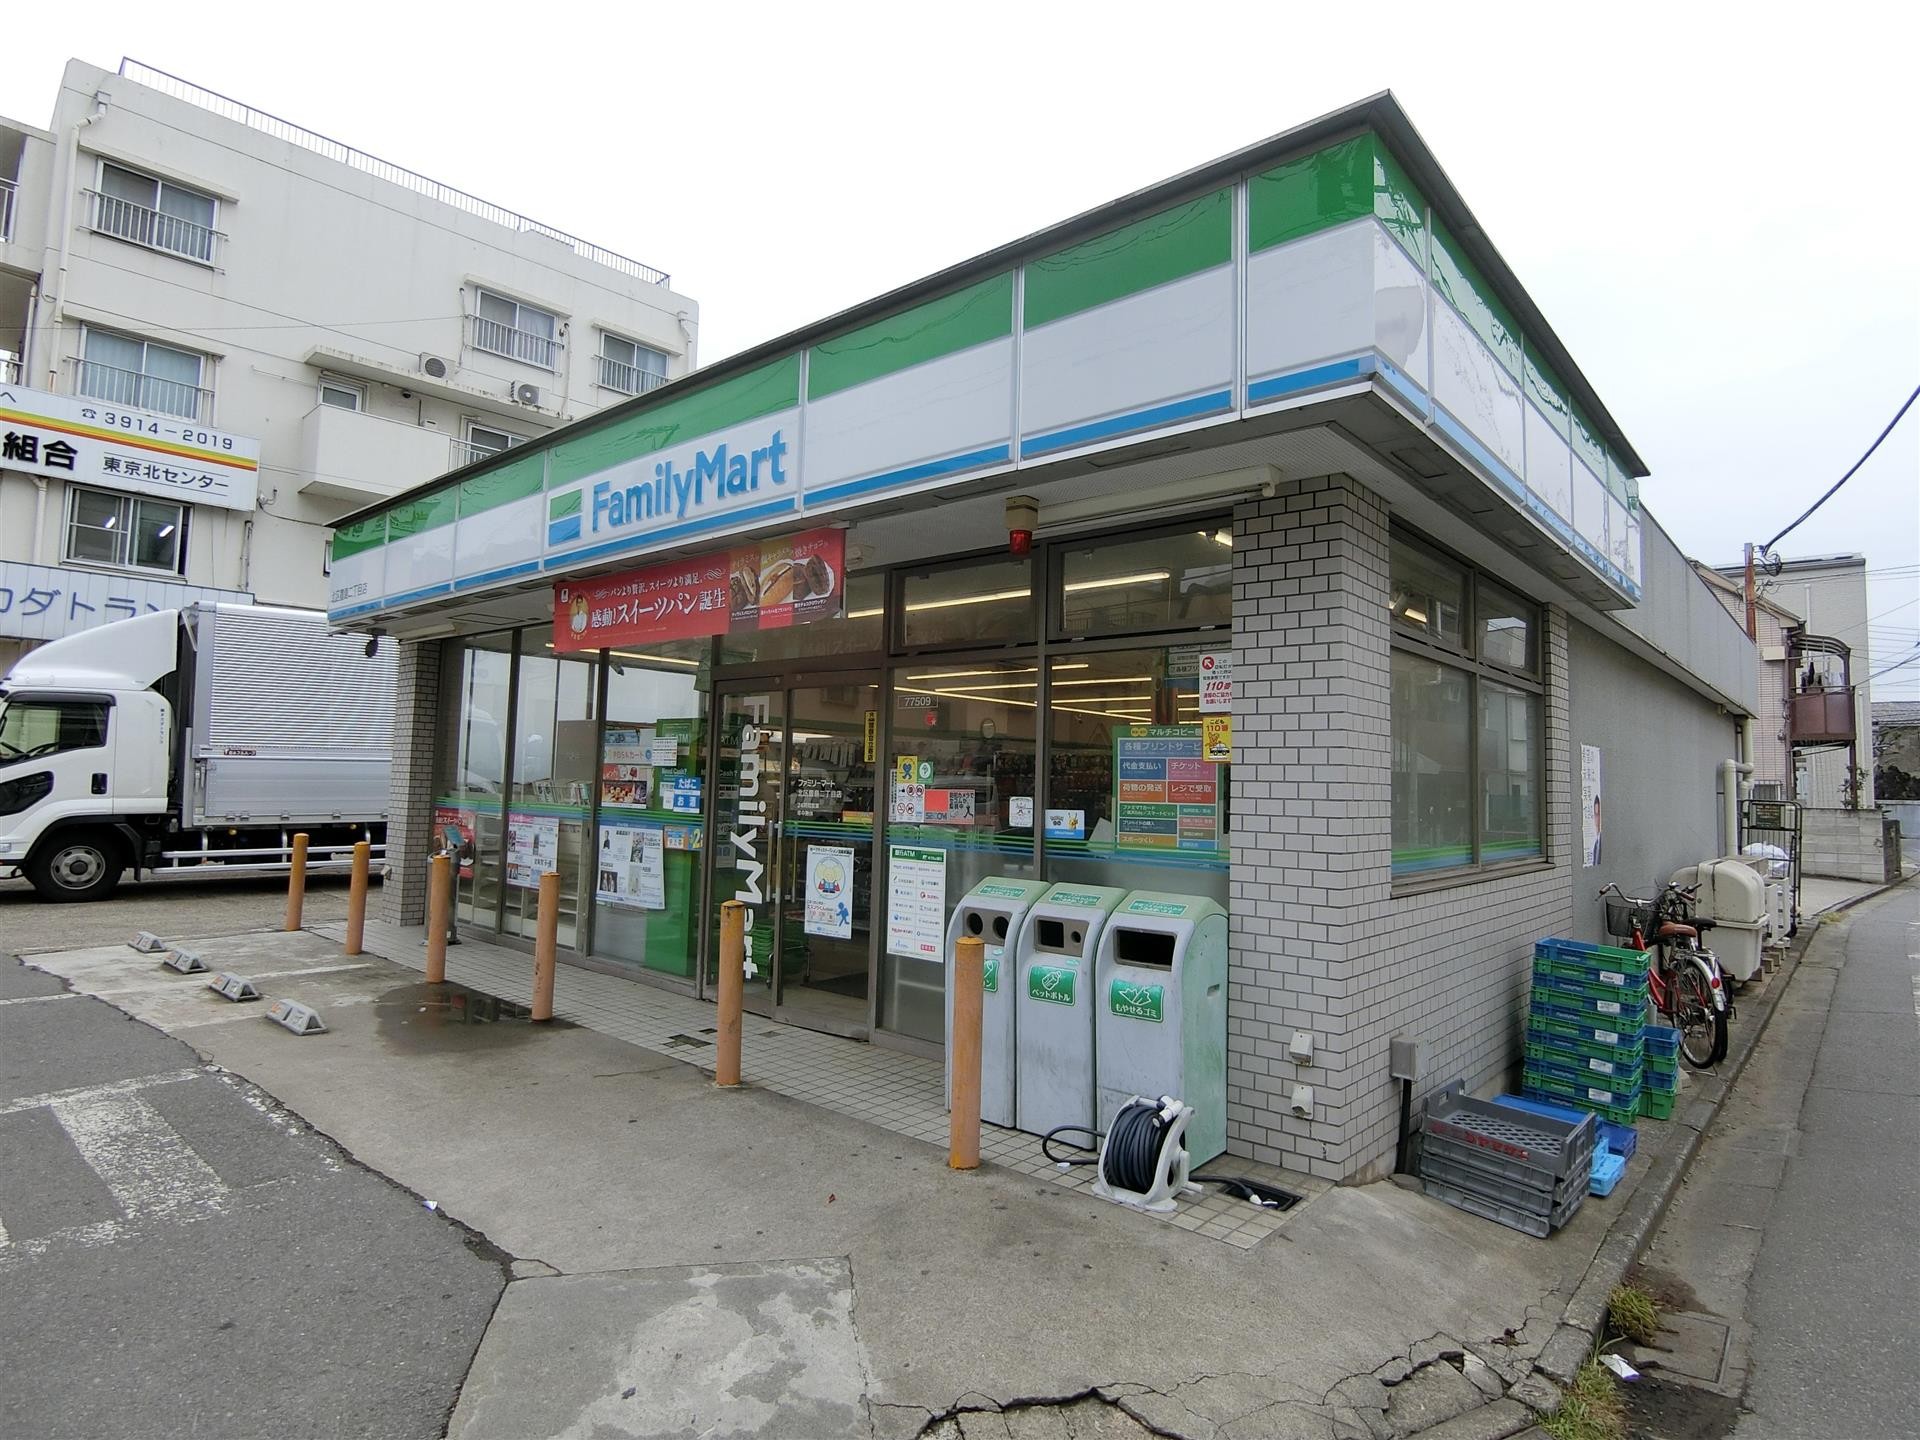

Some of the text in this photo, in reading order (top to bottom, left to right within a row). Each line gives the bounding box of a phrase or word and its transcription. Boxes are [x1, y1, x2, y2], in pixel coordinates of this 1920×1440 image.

[2, 431, 78, 471] 組合
[103, 456, 230, 490] 東京北センター
[592, 429, 788, 533] FamilyMart
[0, 587, 160, 621] ダトラ
[904, 696, 932, 707] 77509
[1123, 761, 1161, 770] 代金支払い
[1171, 761, 1201, 769] チケット
[678, 777, 697, 789] たばこ
[798, 778, 836, 788] ファミリーマート
[1123, 784, 1162, 792] 荷物の発送
[1171, 784, 1212, 792] レジで受取
[730, 695, 769, 979] FamilyMart
[1032, 988, 1070, 1002] ペットボトル
[1116, 1003, 1157, 1018] もやせるゴミ
